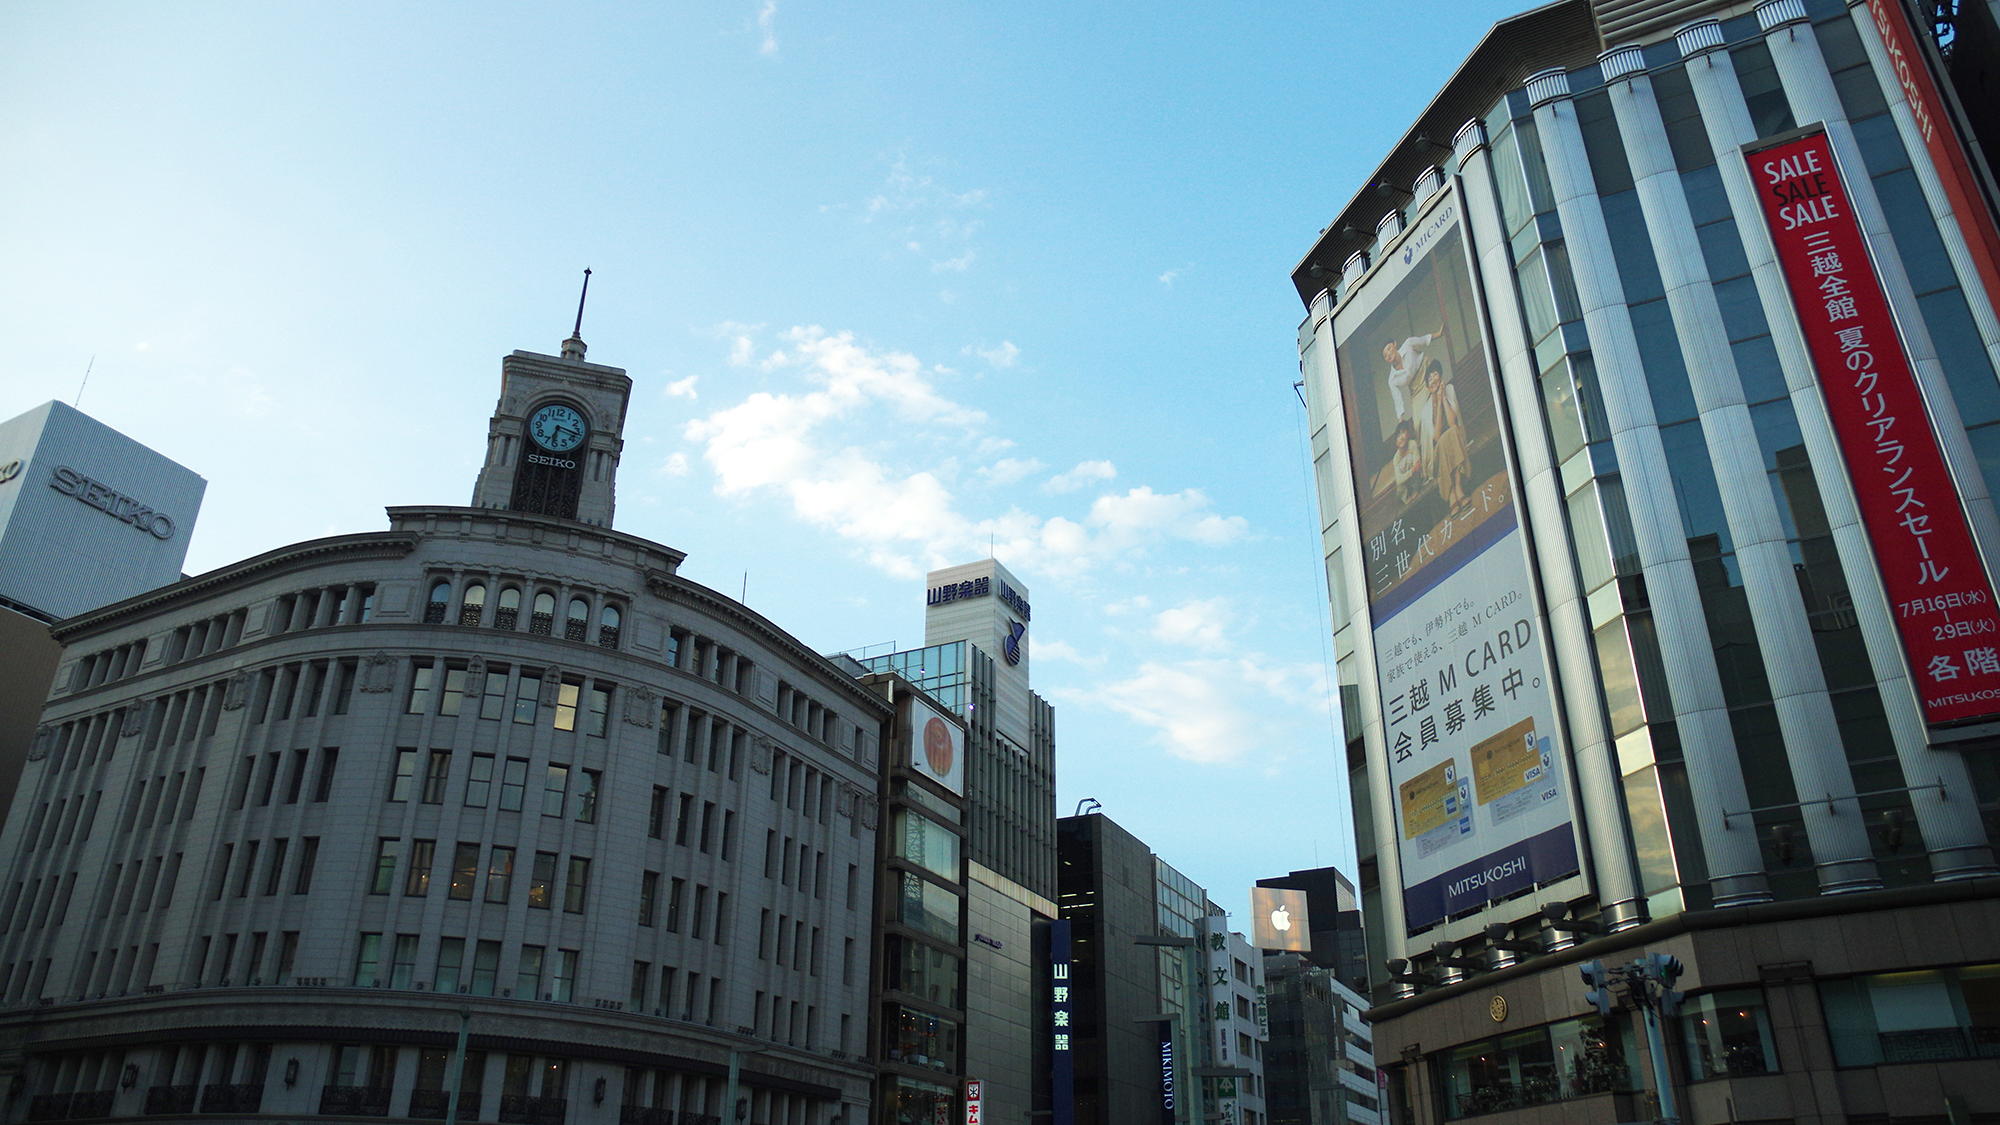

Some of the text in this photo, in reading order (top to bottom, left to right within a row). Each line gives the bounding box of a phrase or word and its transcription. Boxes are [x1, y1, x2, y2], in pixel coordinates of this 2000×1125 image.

[1764, 150, 1822, 184] SALE
[1772, 173, 1830, 206] SALE
[1780, 195, 1839, 230] SALE
[556, 408, 565, 417] 12
[1803, 231, 1949, 585] 三越全館 夏のクリアランスセール
[535, 421, 542, 429] 9
[536, 429, 544, 437] 8
[572, 419, 579, 427] 2
[544, 435, 551, 443] 7
[551, 439, 558, 448] 6
[560, 439, 568, 447] 5
[528, 454, 576, 469] SEIKO
[50, 465, 176, 540] SEIKO
[1376, 484, 1505, 595] 三世代カード。
[927, 576, 989, 606] 山野楽器
[1899, 589, 1987, 618] 7月16日(水)
[1932, 618, 1996, 641] 29日(火)
[1389, 619, 1532, 727] 三越 M CARD
[1394, 668, 1541, 764] 会員募集中。
[1525, 767, 1541, 780] VISA
[1541, 788, 1557, 801] VISA
[1448, 856, 1527, 898] MITSUKOSHI
[1053, 963, 1069, 1051] 山野楽器
[1161, 1041, 1175, 1110] MIKIMOTO
